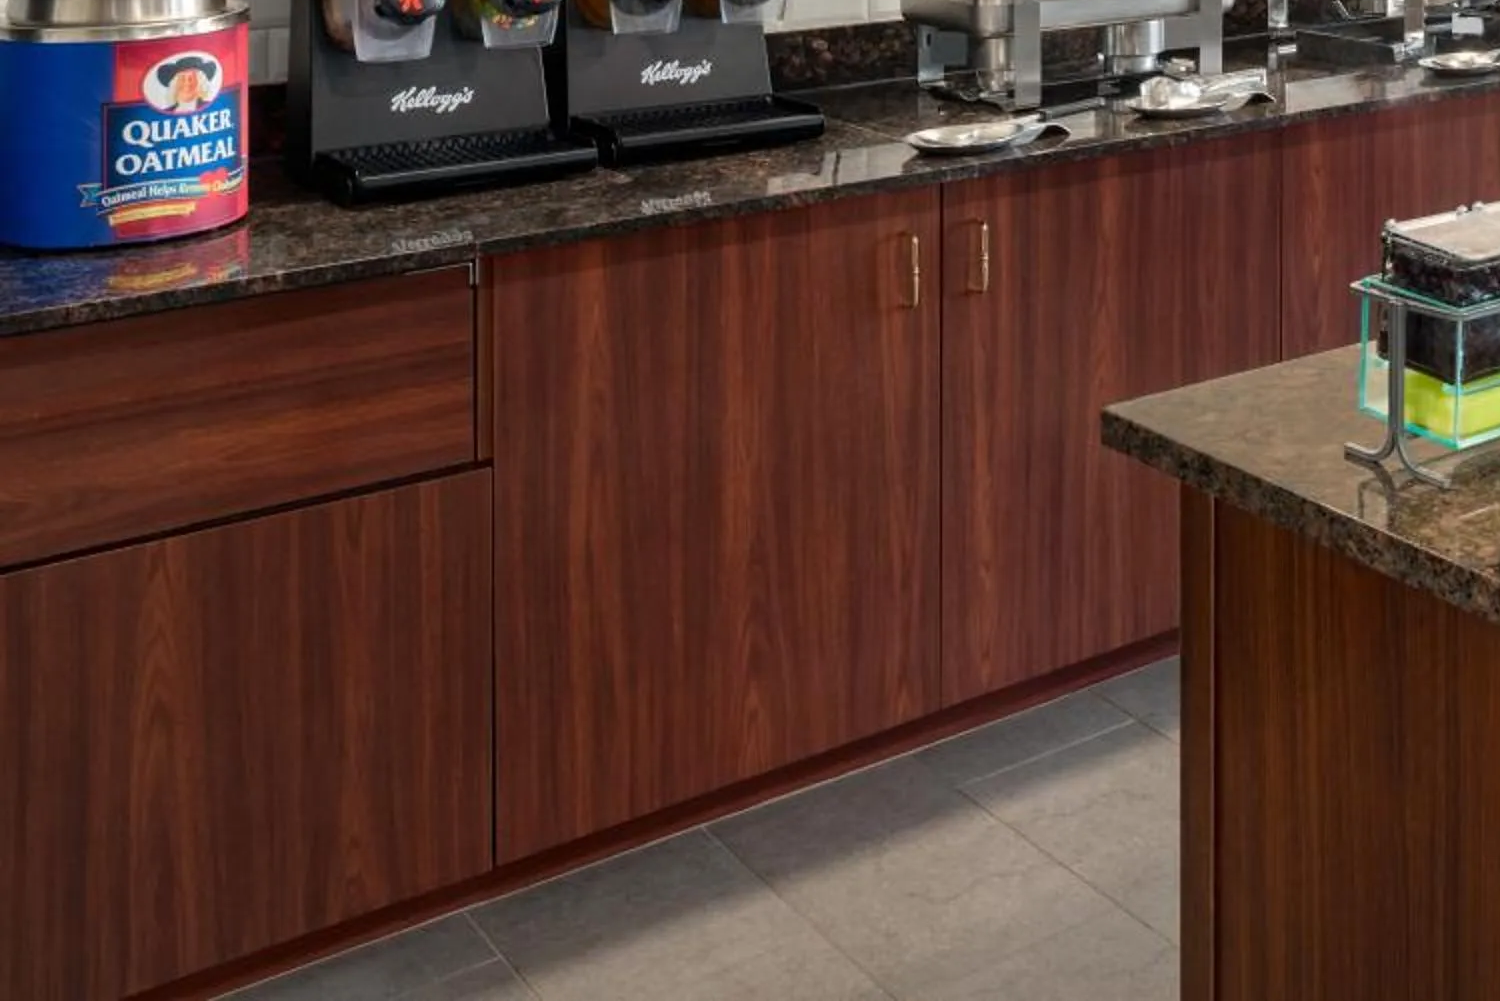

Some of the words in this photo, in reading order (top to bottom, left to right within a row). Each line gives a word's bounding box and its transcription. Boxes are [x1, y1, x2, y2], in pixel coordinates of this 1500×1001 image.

[640, 59, 713, 86] Kellogg's
[391, 86, 475, 114] Kellogg's
[122, 108, 232, 148] QUAKER
[115, 136, 236, 176] OATMEAL
